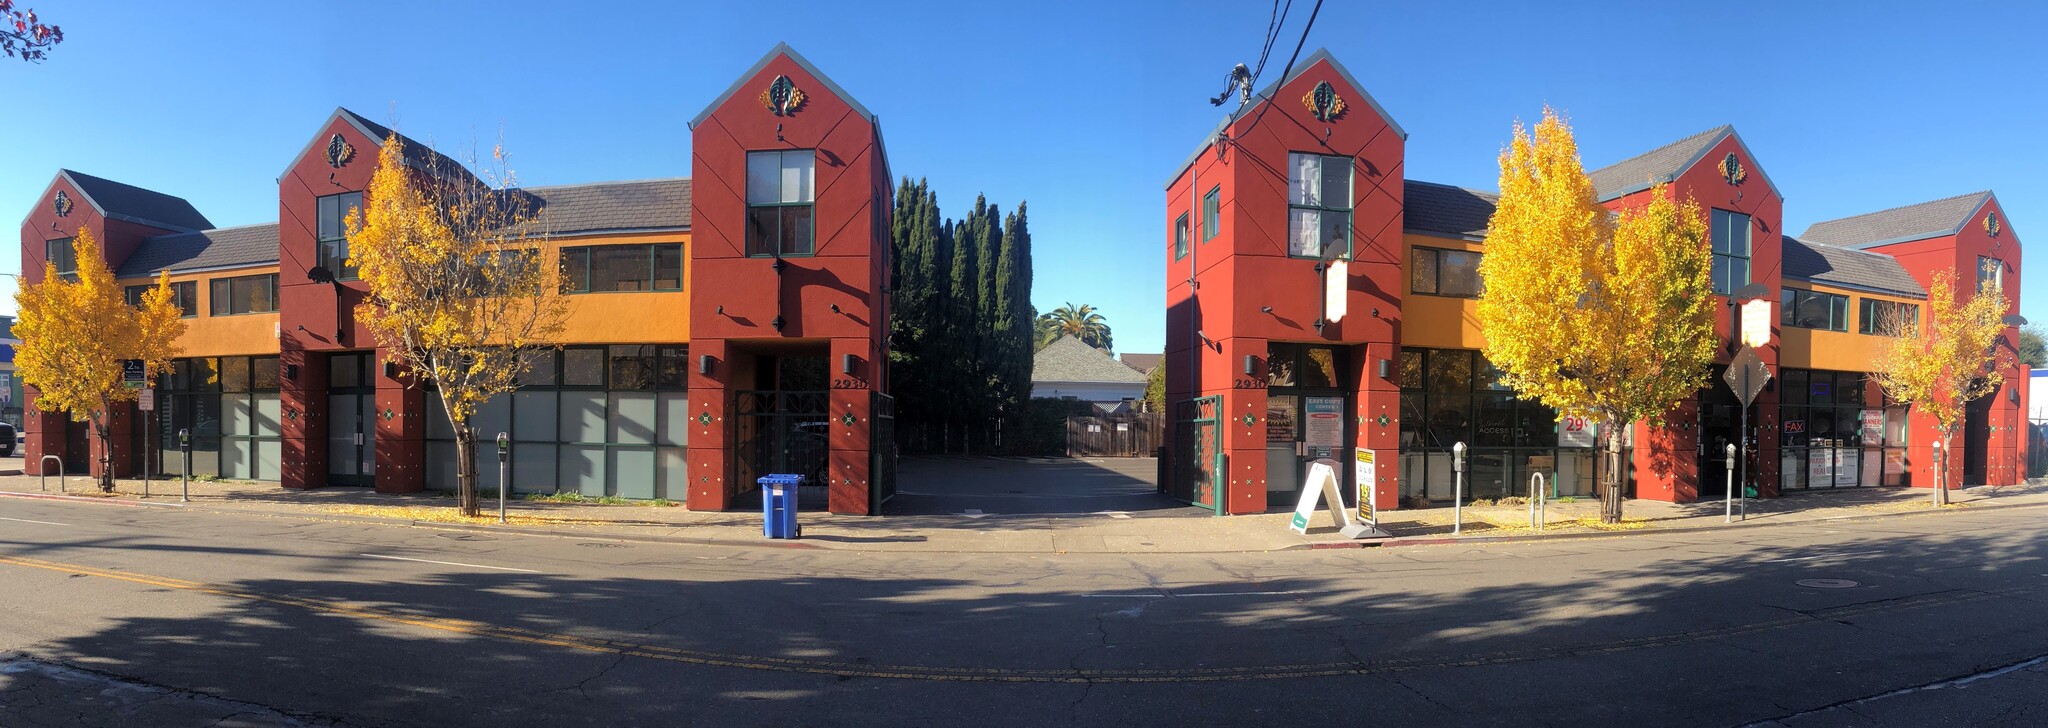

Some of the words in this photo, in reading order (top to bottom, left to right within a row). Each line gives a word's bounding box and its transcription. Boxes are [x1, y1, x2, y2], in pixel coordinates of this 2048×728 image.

[128, 361, 134, 369] 2
[835, 379, 868, 389] 2930
[1235, 379, 1267, 389] 2930
[1785, 422, 1803, 432] FAX
